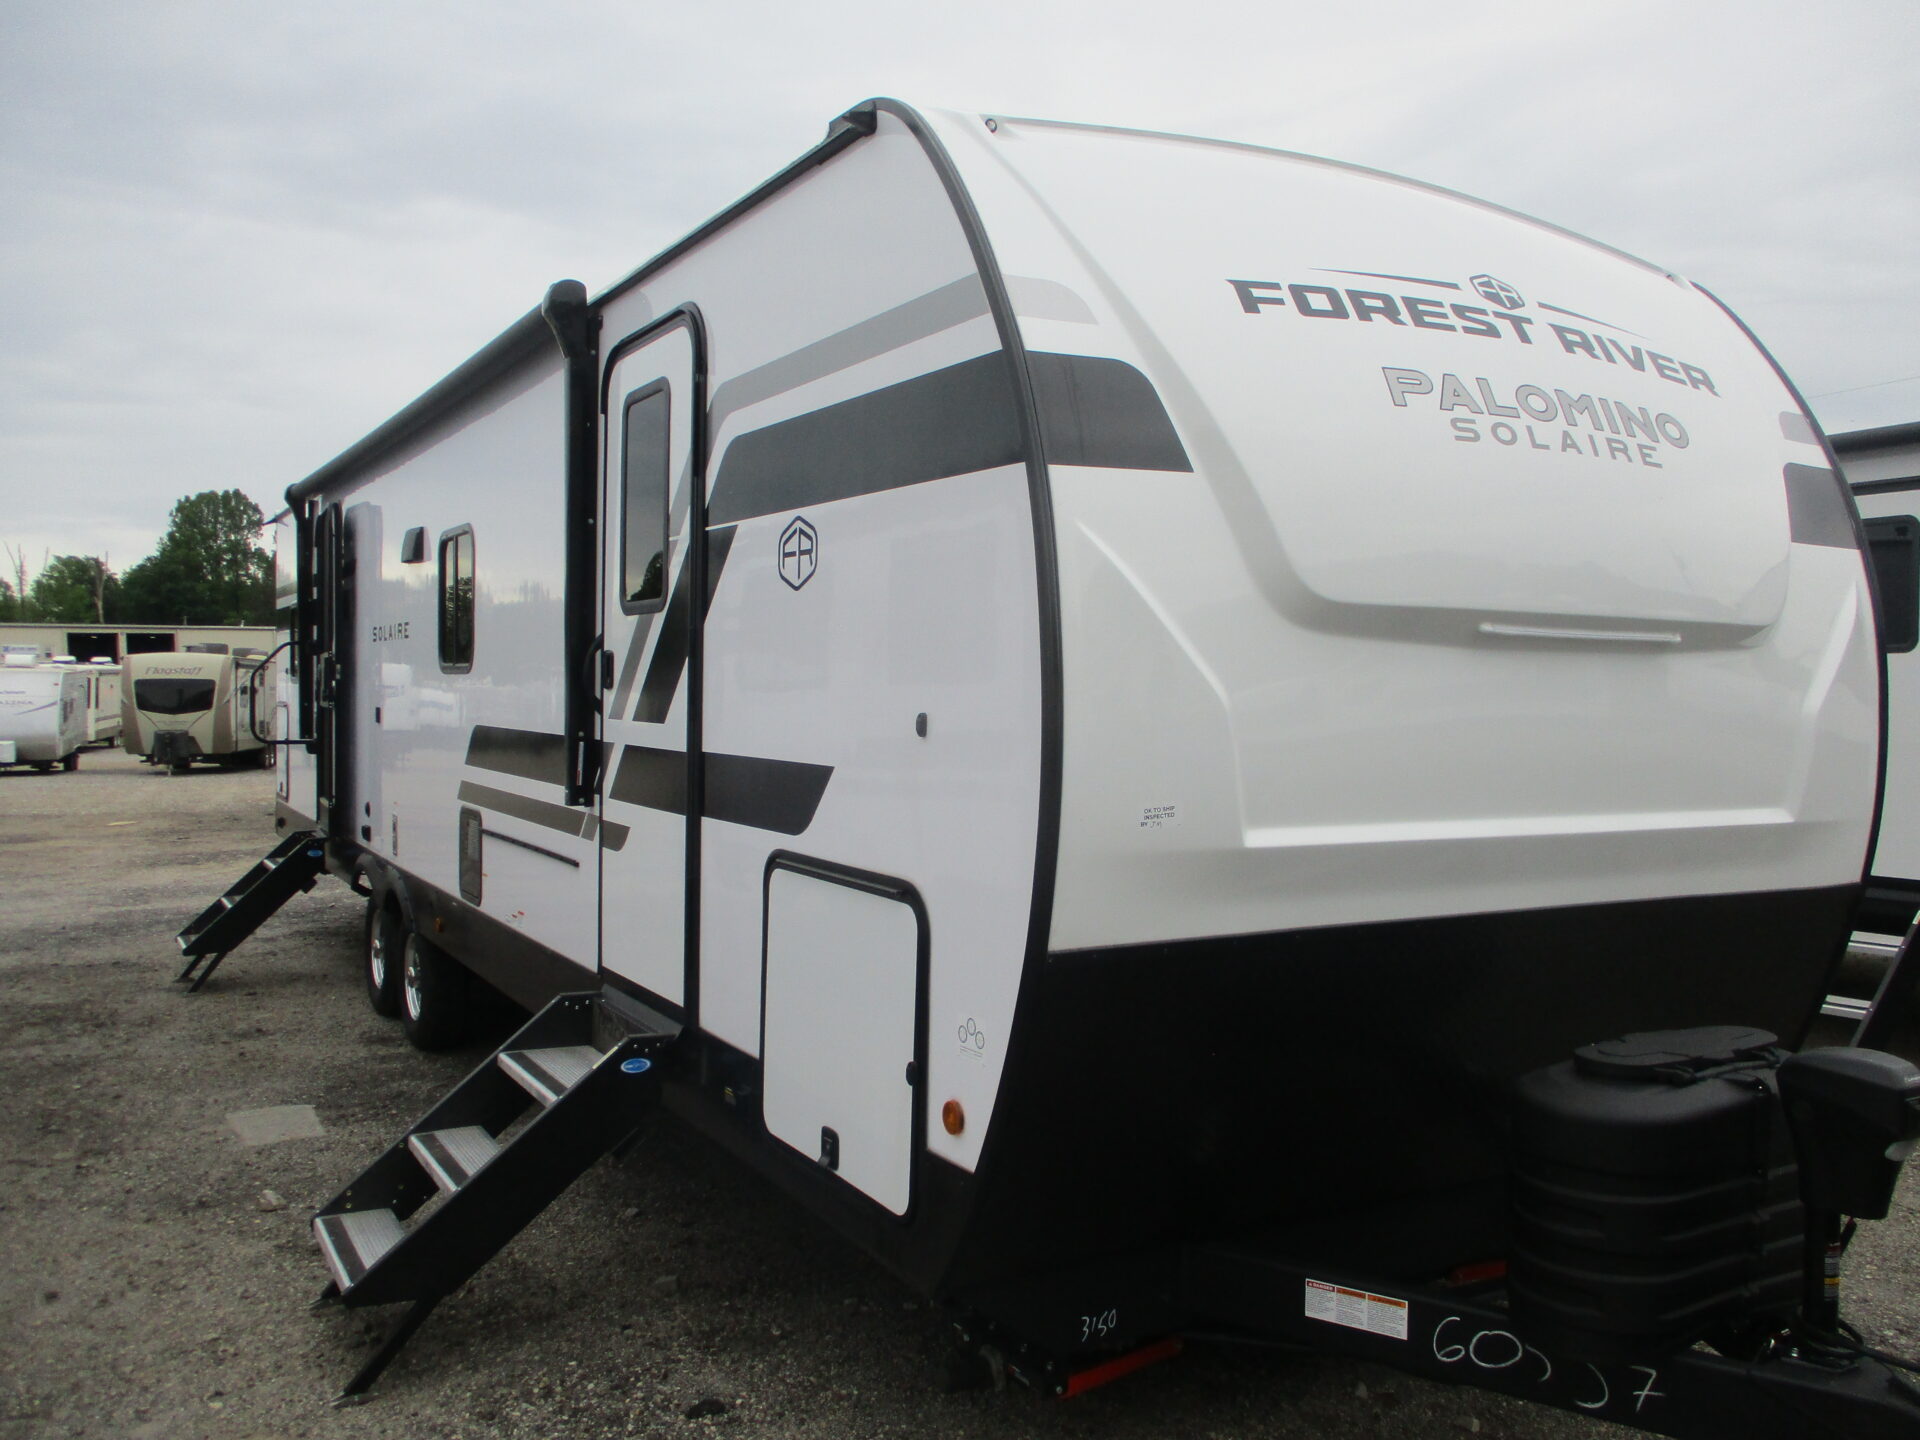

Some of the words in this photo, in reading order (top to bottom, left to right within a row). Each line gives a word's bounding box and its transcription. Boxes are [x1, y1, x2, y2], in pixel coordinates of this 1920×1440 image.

[1225, 279, 1533, 344] FOREST
[1547, 322, 1721, 398] RIVER
[1381, 366, 1690, 449] PALOMINO
[1450, 416, 1663, 469] SOLAIRE
[373, 622, 409, 642] SOLAIRE
[1144, 812, 1175, 820] INSPECTED
[1081, 1309, 1116, 1342] 3150
